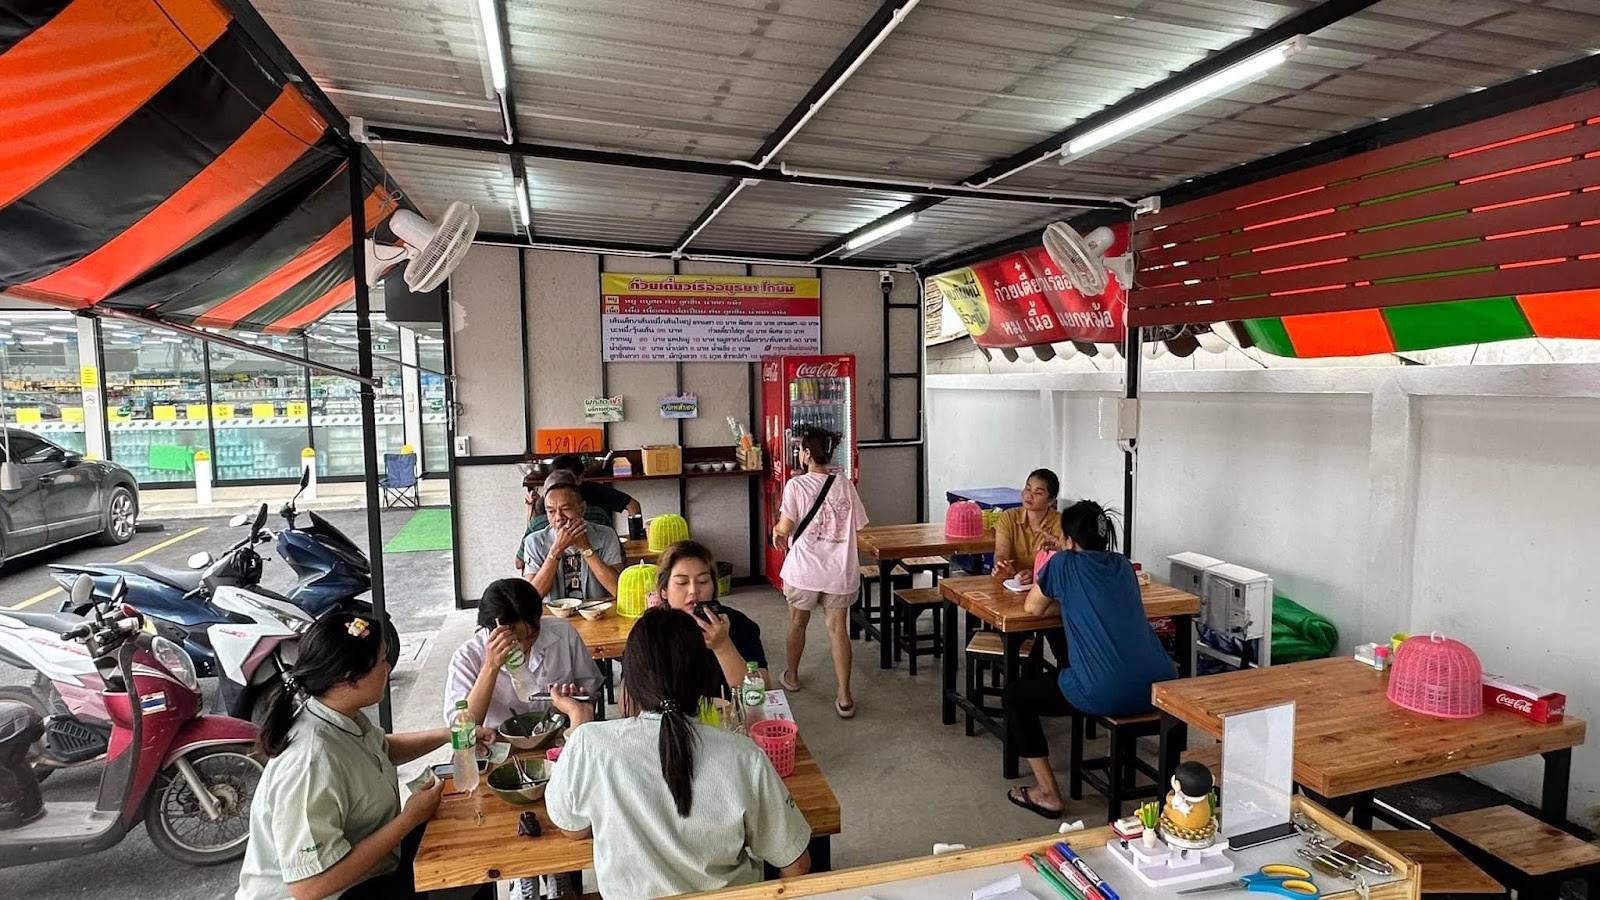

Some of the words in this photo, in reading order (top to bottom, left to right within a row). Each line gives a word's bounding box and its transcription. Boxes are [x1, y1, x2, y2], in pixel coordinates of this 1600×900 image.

[1000, 319, 1028, 341] หมู
[1024, 299, 1053, 332] เนื้อ
[1056, 302, 1114, 329] แยกหม้อ
[796, 362, 840, 378] Coca-Cola
[1496, 693, 1532, 714] Coca-Cola
